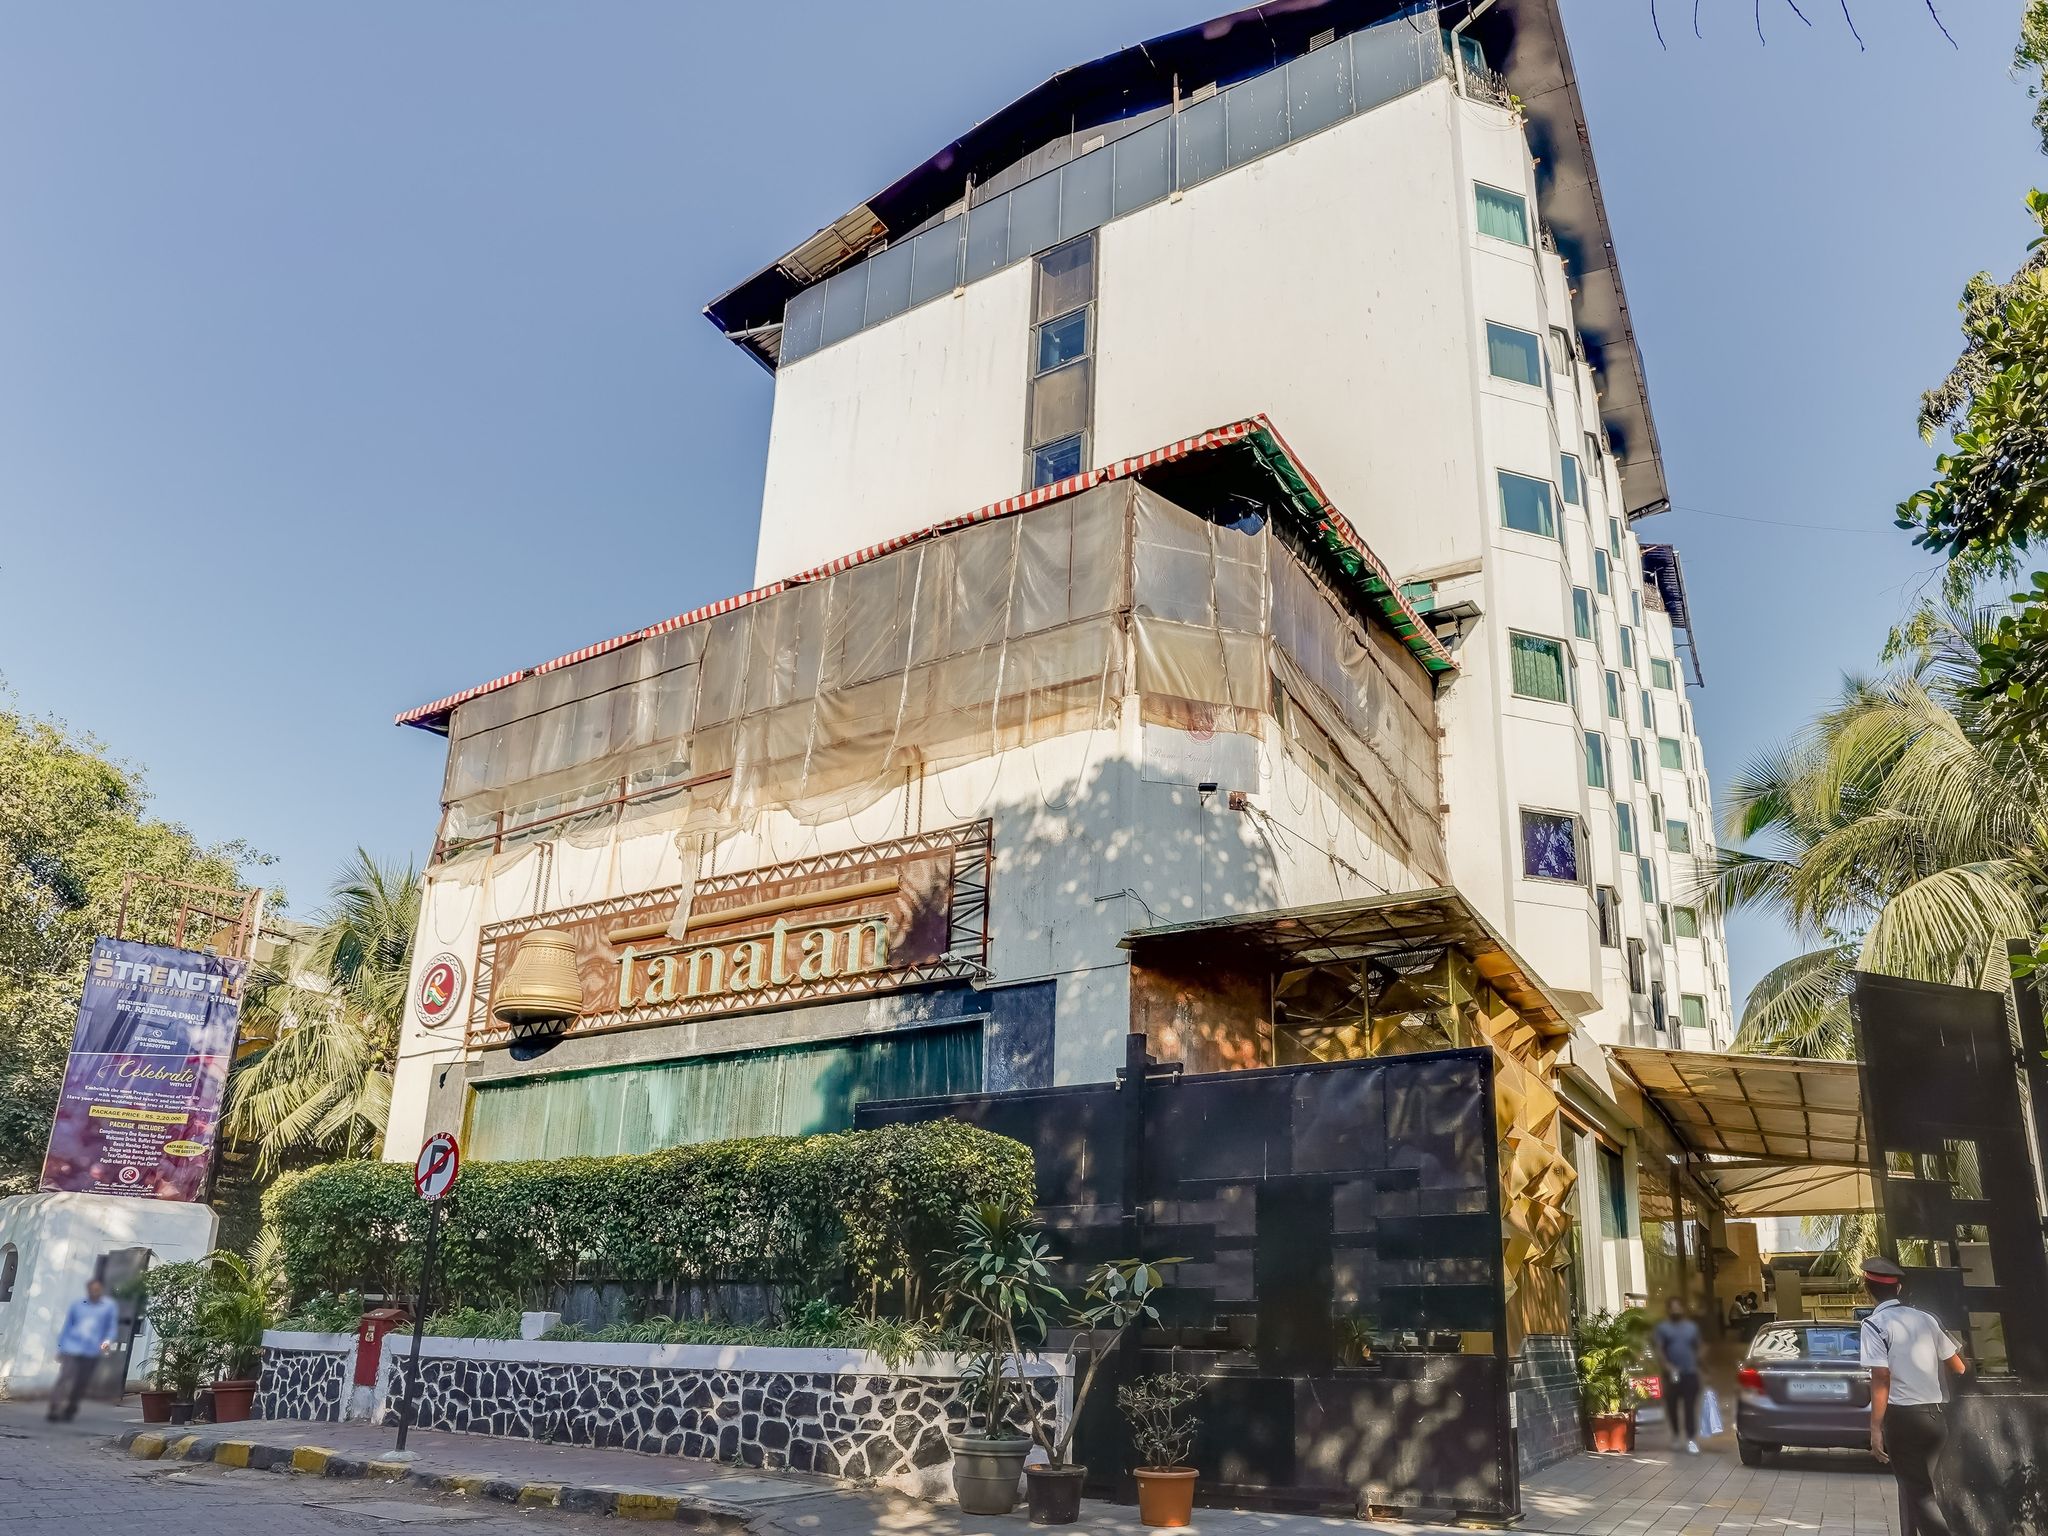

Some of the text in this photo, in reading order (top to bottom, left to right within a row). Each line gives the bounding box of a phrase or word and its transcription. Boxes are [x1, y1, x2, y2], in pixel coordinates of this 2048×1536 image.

[616, 917, 893, 1008] tanatan
[93, 960, 240, 998] STRENGTH
[91, 979, 130, 990] TRAINING
[139, 985, 209, 1002] TRANSFORMATION
[210, 995, 236, 1006] STUDIO
[116, 1004, 206, 1022] MR. RAJENDRA DHOLE
[97, 1060, 196, 1082] Celebrate
[432, 1133, 450, 1142] MTP
